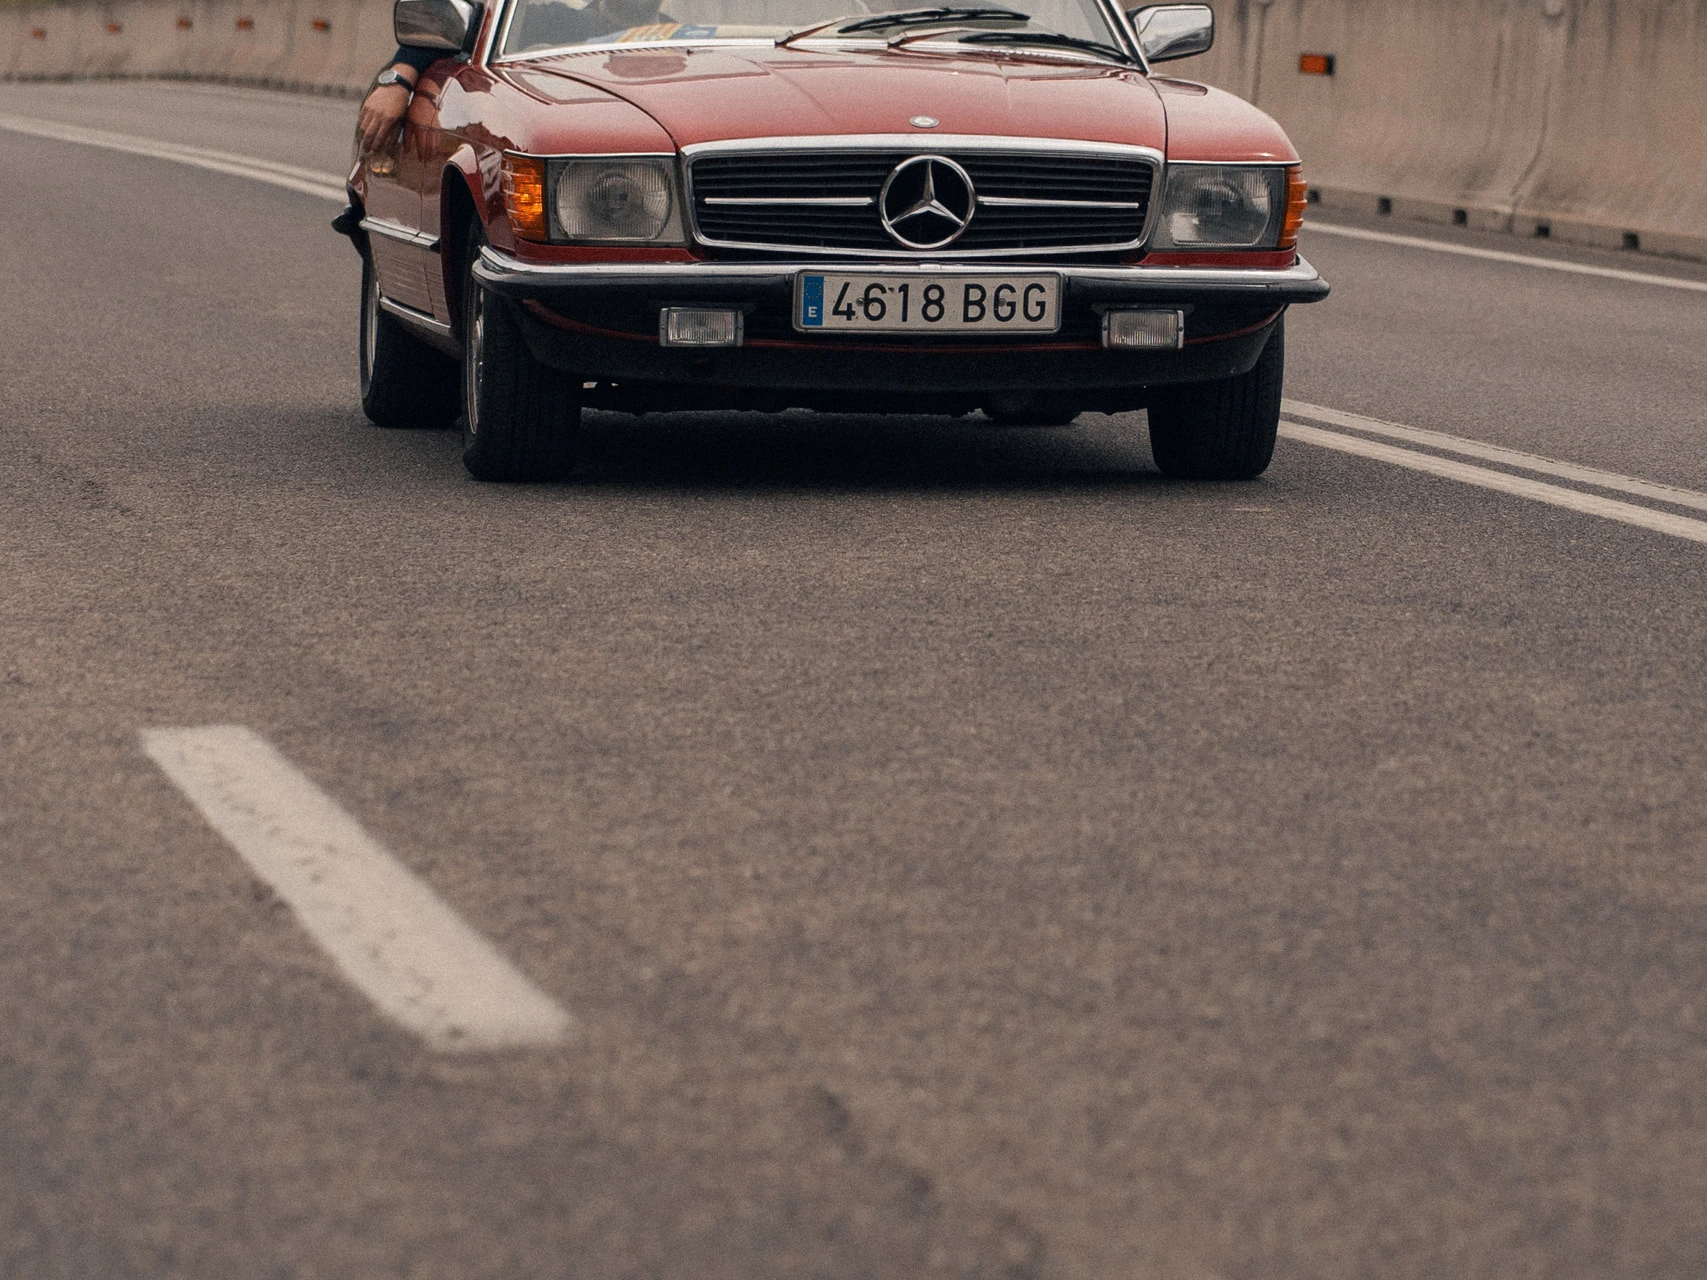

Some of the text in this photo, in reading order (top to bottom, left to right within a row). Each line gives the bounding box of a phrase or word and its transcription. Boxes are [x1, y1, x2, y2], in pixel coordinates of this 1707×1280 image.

[807, 282, 1046, 323] E 4618 BGG
